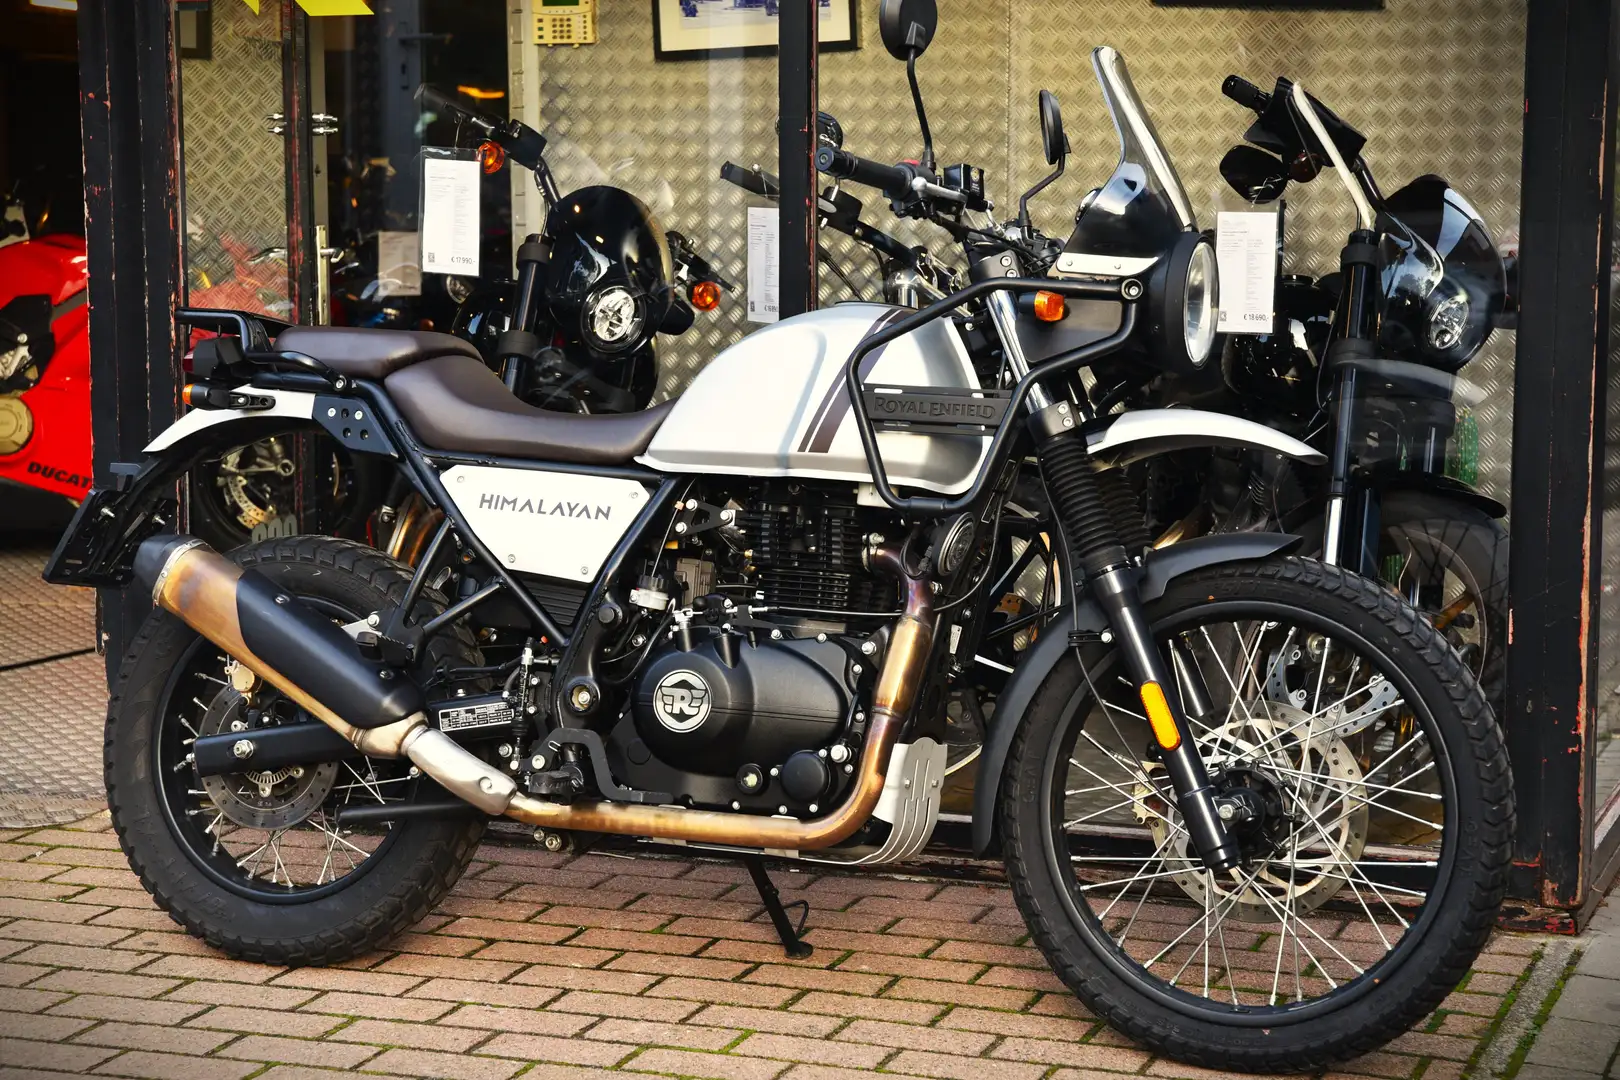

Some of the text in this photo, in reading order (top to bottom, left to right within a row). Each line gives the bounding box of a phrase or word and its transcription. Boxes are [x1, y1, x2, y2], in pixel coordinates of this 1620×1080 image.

[874, 396, 996, 419] ROYAL ENFIELD
[27, 461, 93, 489] DUCAT
[478, 493, 612, 521] HIMALAYAN
